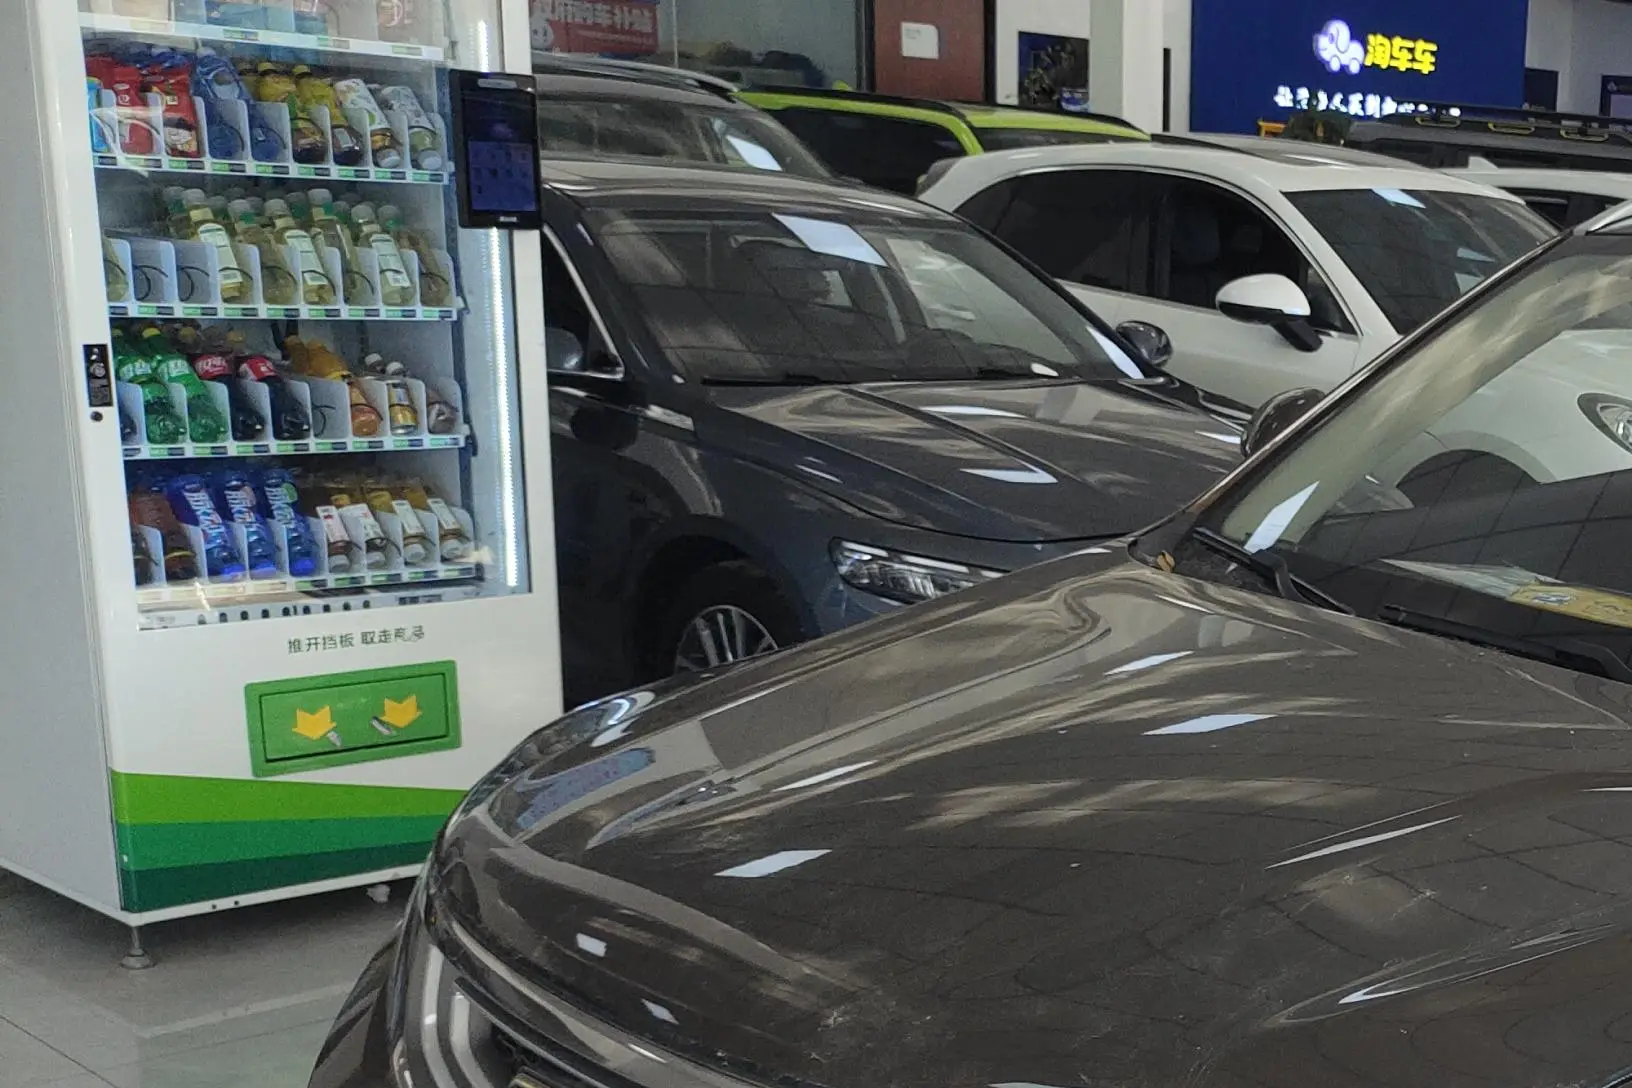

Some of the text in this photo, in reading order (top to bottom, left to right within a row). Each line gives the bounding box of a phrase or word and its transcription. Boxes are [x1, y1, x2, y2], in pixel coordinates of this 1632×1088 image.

[1363, 33, 1438, 74] 淘车车
[288, 633, 355, 654] 推开挡板
